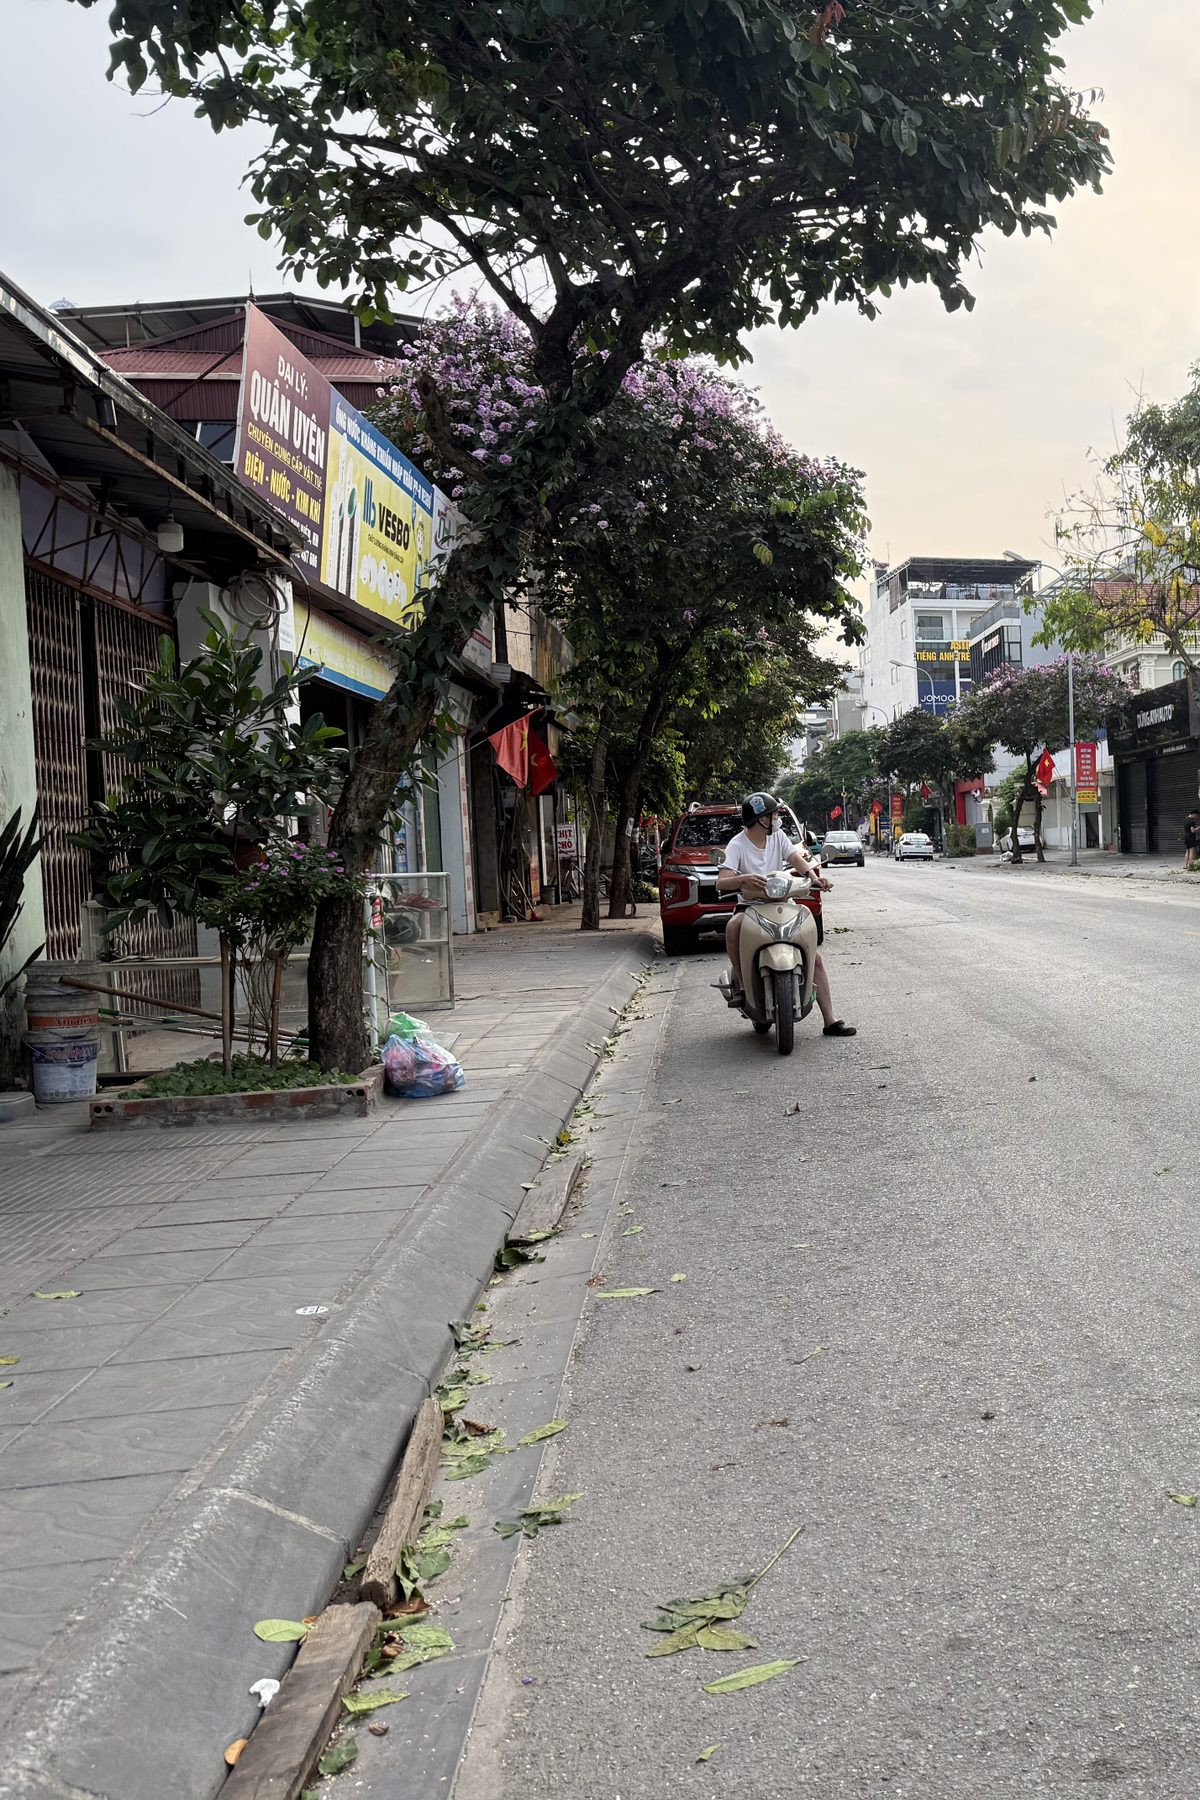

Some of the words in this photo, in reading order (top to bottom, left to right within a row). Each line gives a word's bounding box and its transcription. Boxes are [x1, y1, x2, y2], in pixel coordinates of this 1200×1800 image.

[278, 354, 294, 390] ĐẠI
[295, 372, 308, 400] LÝ:
[250, 369, 291, 441] QUÂN
[293, 406, 325, 469] UYÊN
[248, 422, 274, 452] CHUYÊN
[274, 442, 292, 465] CUNG
[291, 455, 304, 475] CẤP
[245, 450, 265, 486] ĐIỆN
[271, 470, 291, 503] NƯỚC
[296, 487, 310, 517] KIM
[310, 498, 321, 524] KHÍ
[379, 502, 410, 551] VESBO
[916, 649, 937, 661] TIẾNG
[939, 651, 955, 661] ANH
[920, 694, 955, 702] JOMOO
[558, 829, 573, 840] HỊT
